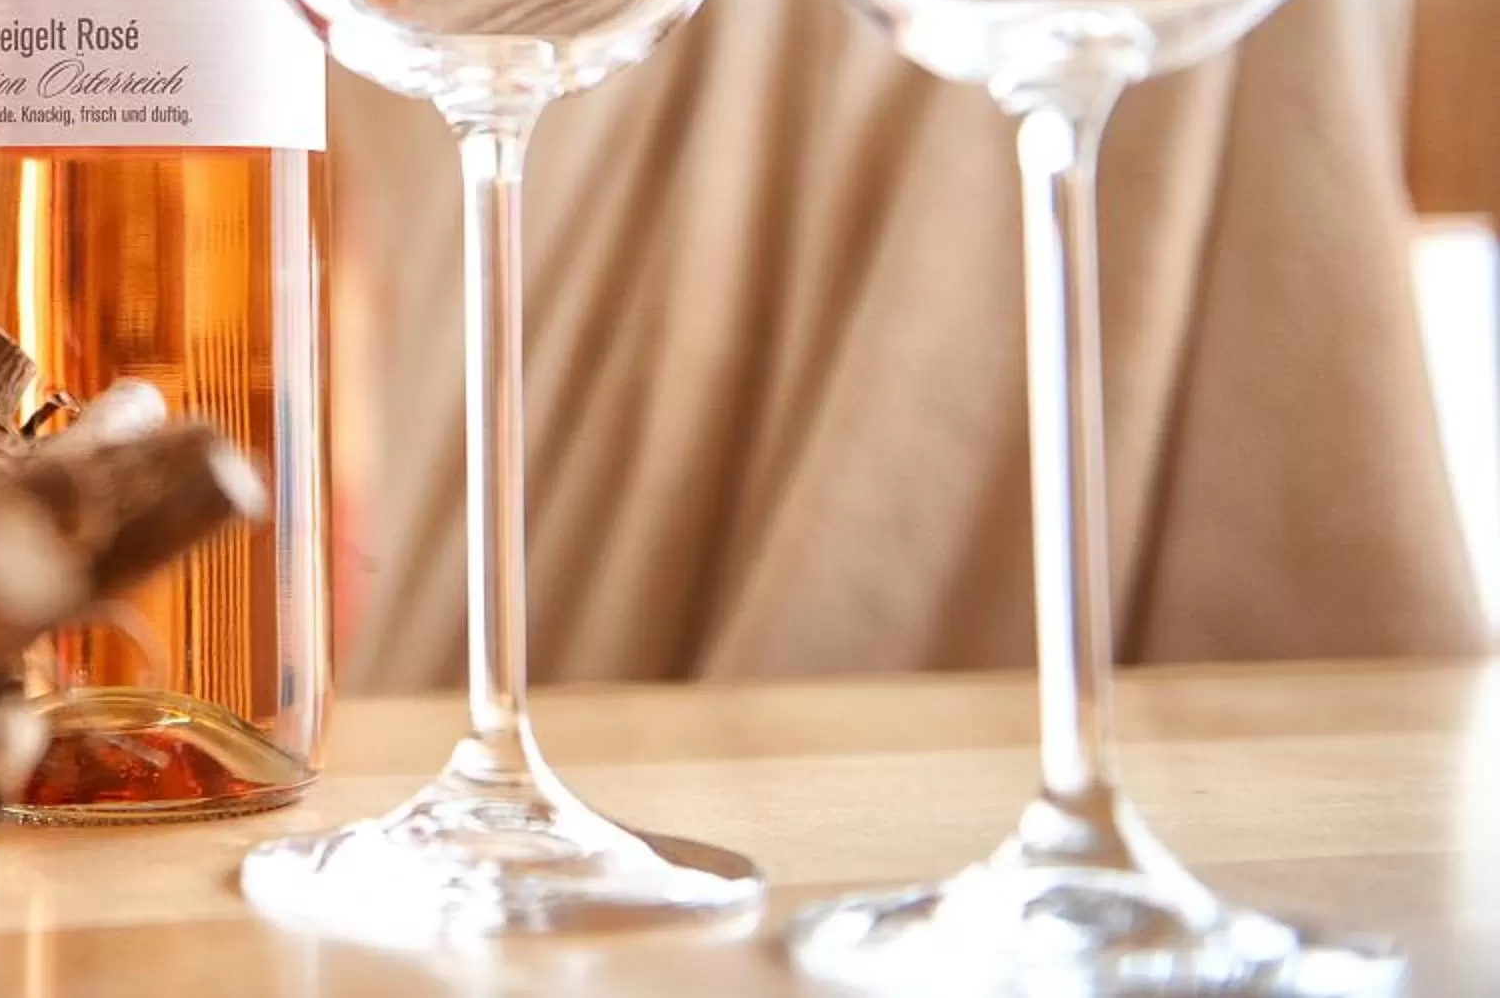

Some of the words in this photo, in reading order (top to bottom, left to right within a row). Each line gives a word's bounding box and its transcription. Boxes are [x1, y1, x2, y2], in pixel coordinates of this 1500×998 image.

[77, 17, 139, 51] Rosé
[37, 52, 189, 99] Österreich
[21, 105, 75, 126] Knackig,
[81, 105, 117, 123] frisch
[121, 105, 147, 123] und
[151, 105, 193, 126] duftig.
